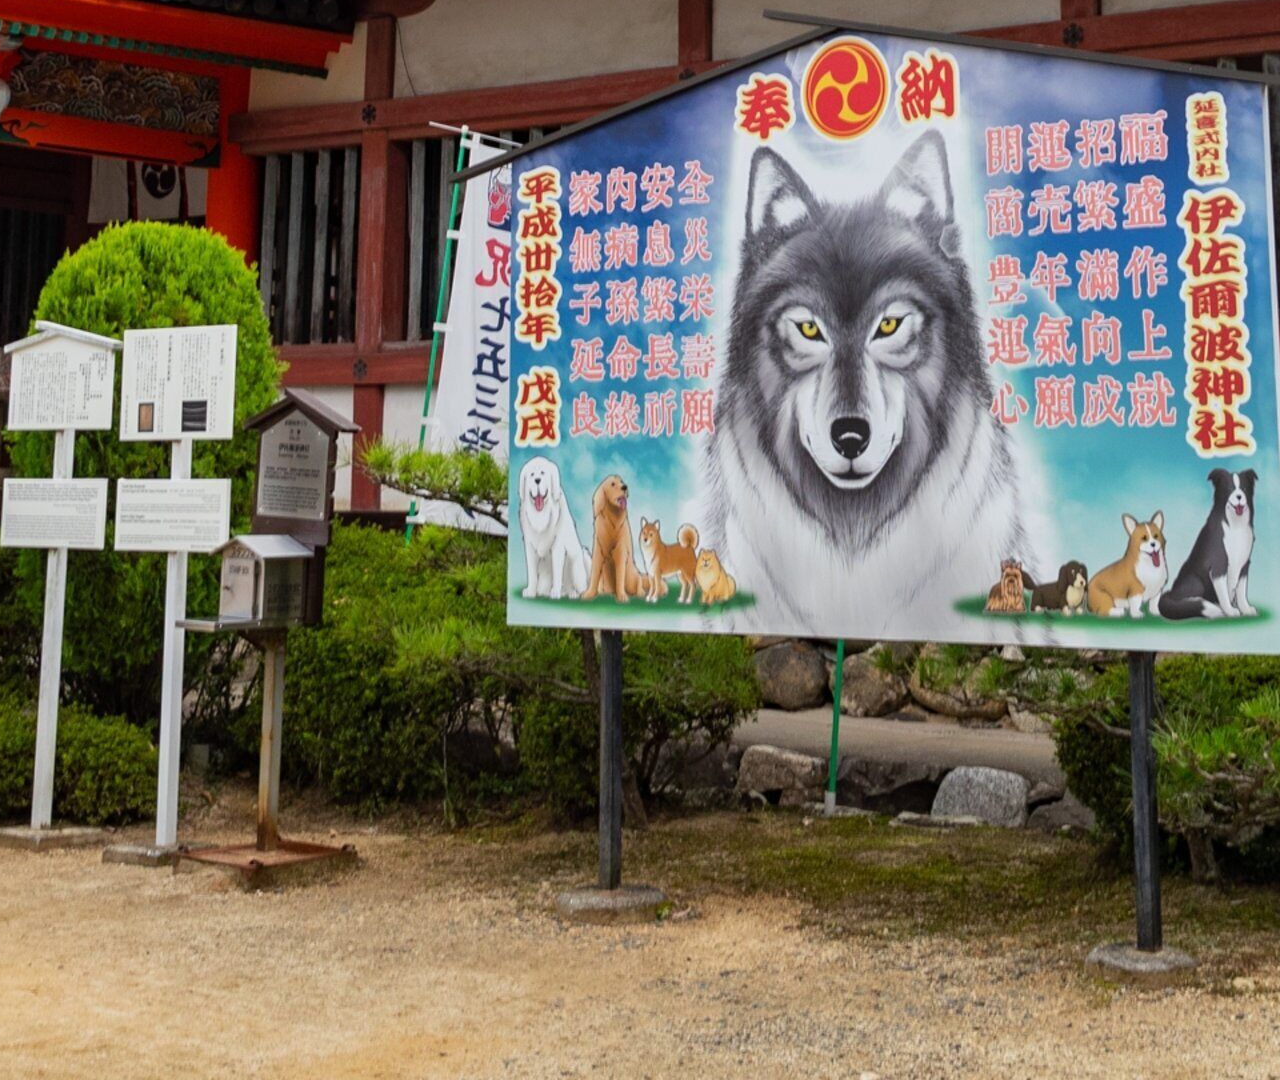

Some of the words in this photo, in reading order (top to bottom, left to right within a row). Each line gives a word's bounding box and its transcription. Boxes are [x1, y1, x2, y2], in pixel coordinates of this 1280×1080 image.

[741, 78, 790, 139] 奉
[900, 54, 954, 121] 納
[986, 110, 1168, 175] 開運招福
[985, 175, 1167, 239] 商売繁盛
[570, 217, 712, 272] 無病息災
[570, 272, 715, 325] 子孫繁栄
[1184, 194, 1250, 451] 伊佐爾波神社
[991, 371, 1177, 427] 心願成就
